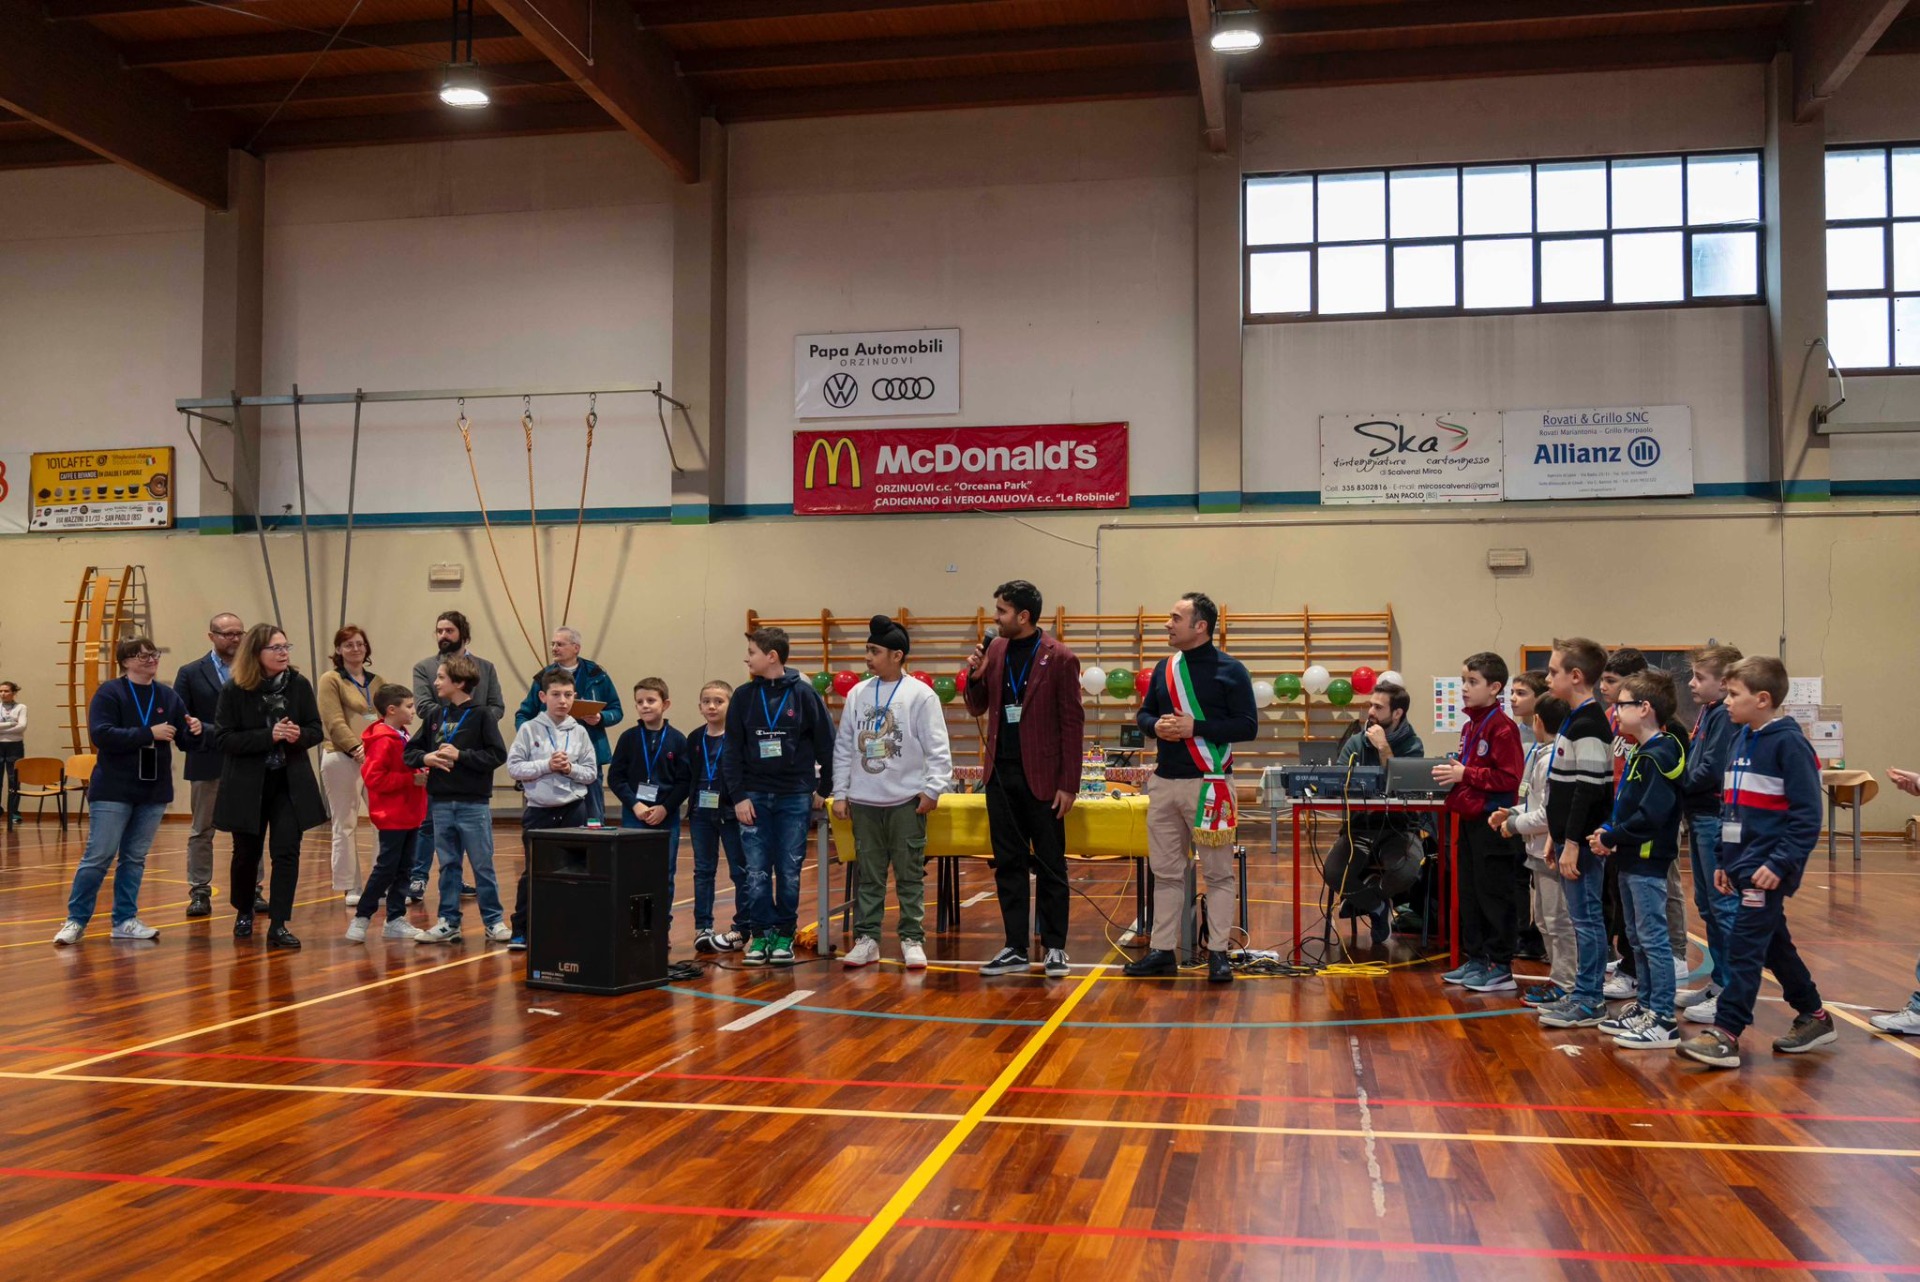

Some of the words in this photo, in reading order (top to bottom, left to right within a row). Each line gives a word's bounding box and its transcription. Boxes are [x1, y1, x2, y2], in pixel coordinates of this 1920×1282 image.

[809, 344, 849, 360] Papa
[855, 338, 943, 357] Automobili
[839, 356, 913, 367] ORZINUOVI
[1543, 414, 1577, 425] Rovati
[1580, 413, 1589, 424] &
[1592, 412, 1623, 424] Grillo
[1626, 411, 1649, 422] SNC
[1560, 428, 1598, 436] Mariantonia
[1623, 426, 1654, 435] Pierpaolo
[1353, 421, 1439, 457] Ska
[875, 440, 1098, 475] McDonald's
[1533, 443, 1622, 465] Allianz
[1333, 456, 1407, 473] tinteggiature
[1426, 454, 1491, 472] cartongesso
[1387, 468, 1421, 476] Scalvenzi
[1422, 467, 1443, 475] Mirco
[875, 483, 934, 493] ORZINUOVI
[936, 484, 952, 492] c.c.
[1356, 483, 1388, 491] 8302816
[875, 496, 940, 507] CADIGNANO
[941, 495, 952, 505] di
[953, 494, 1035, 504] VEROLANUOVA
[1037, 495, 1054, 503] c.c.
